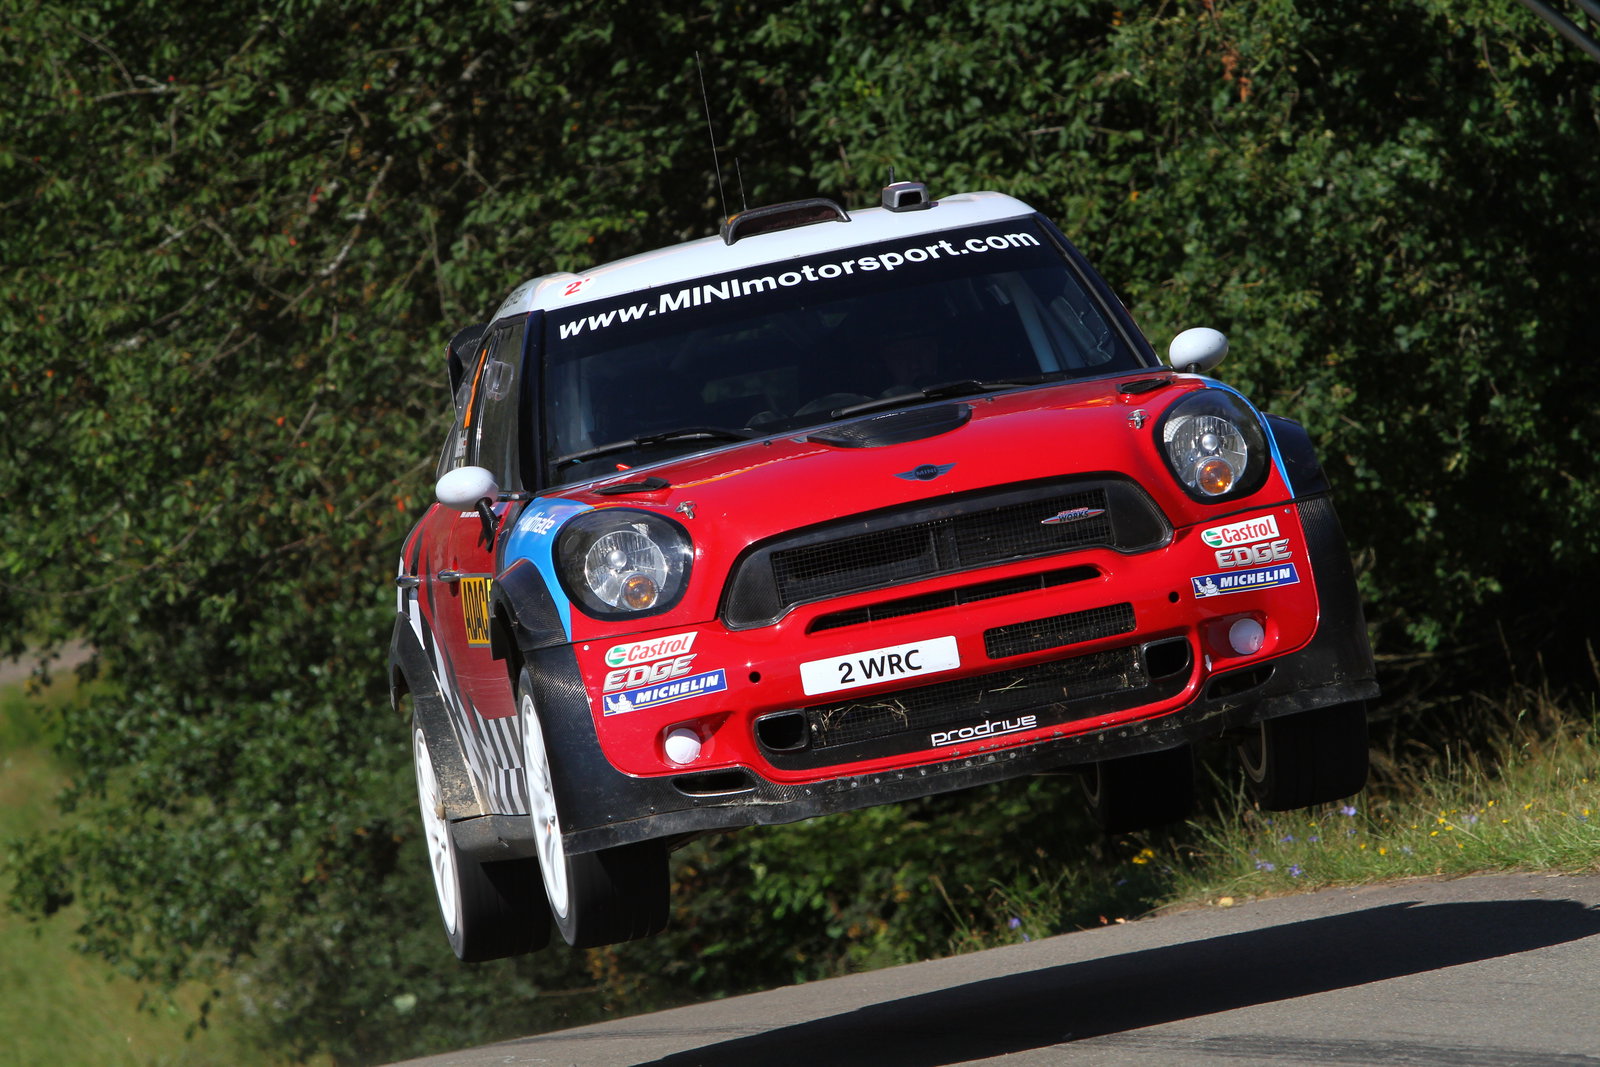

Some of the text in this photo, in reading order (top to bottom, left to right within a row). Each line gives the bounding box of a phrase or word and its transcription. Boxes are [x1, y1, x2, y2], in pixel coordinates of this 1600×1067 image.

[559, 229, 1040, 340] www.MINImotorsport.com
[1058, 510, 1089, 522] WORKS
[1221, 518, 1275, 544] Castrol
[1214, 538, 1293, 569] EDGE
[1220, 567, 1291, 588] MICHELIN
[463, 580, 489, 641] ADAC
[627, 635, 689, 662] Castrol
[603, 653, 698, 693] EDGE
[838, 649, 923, 684] 2 WRC
[635, 674, 720, 704] MICHELIN
[930, 714, 1037, 747] prodrive
